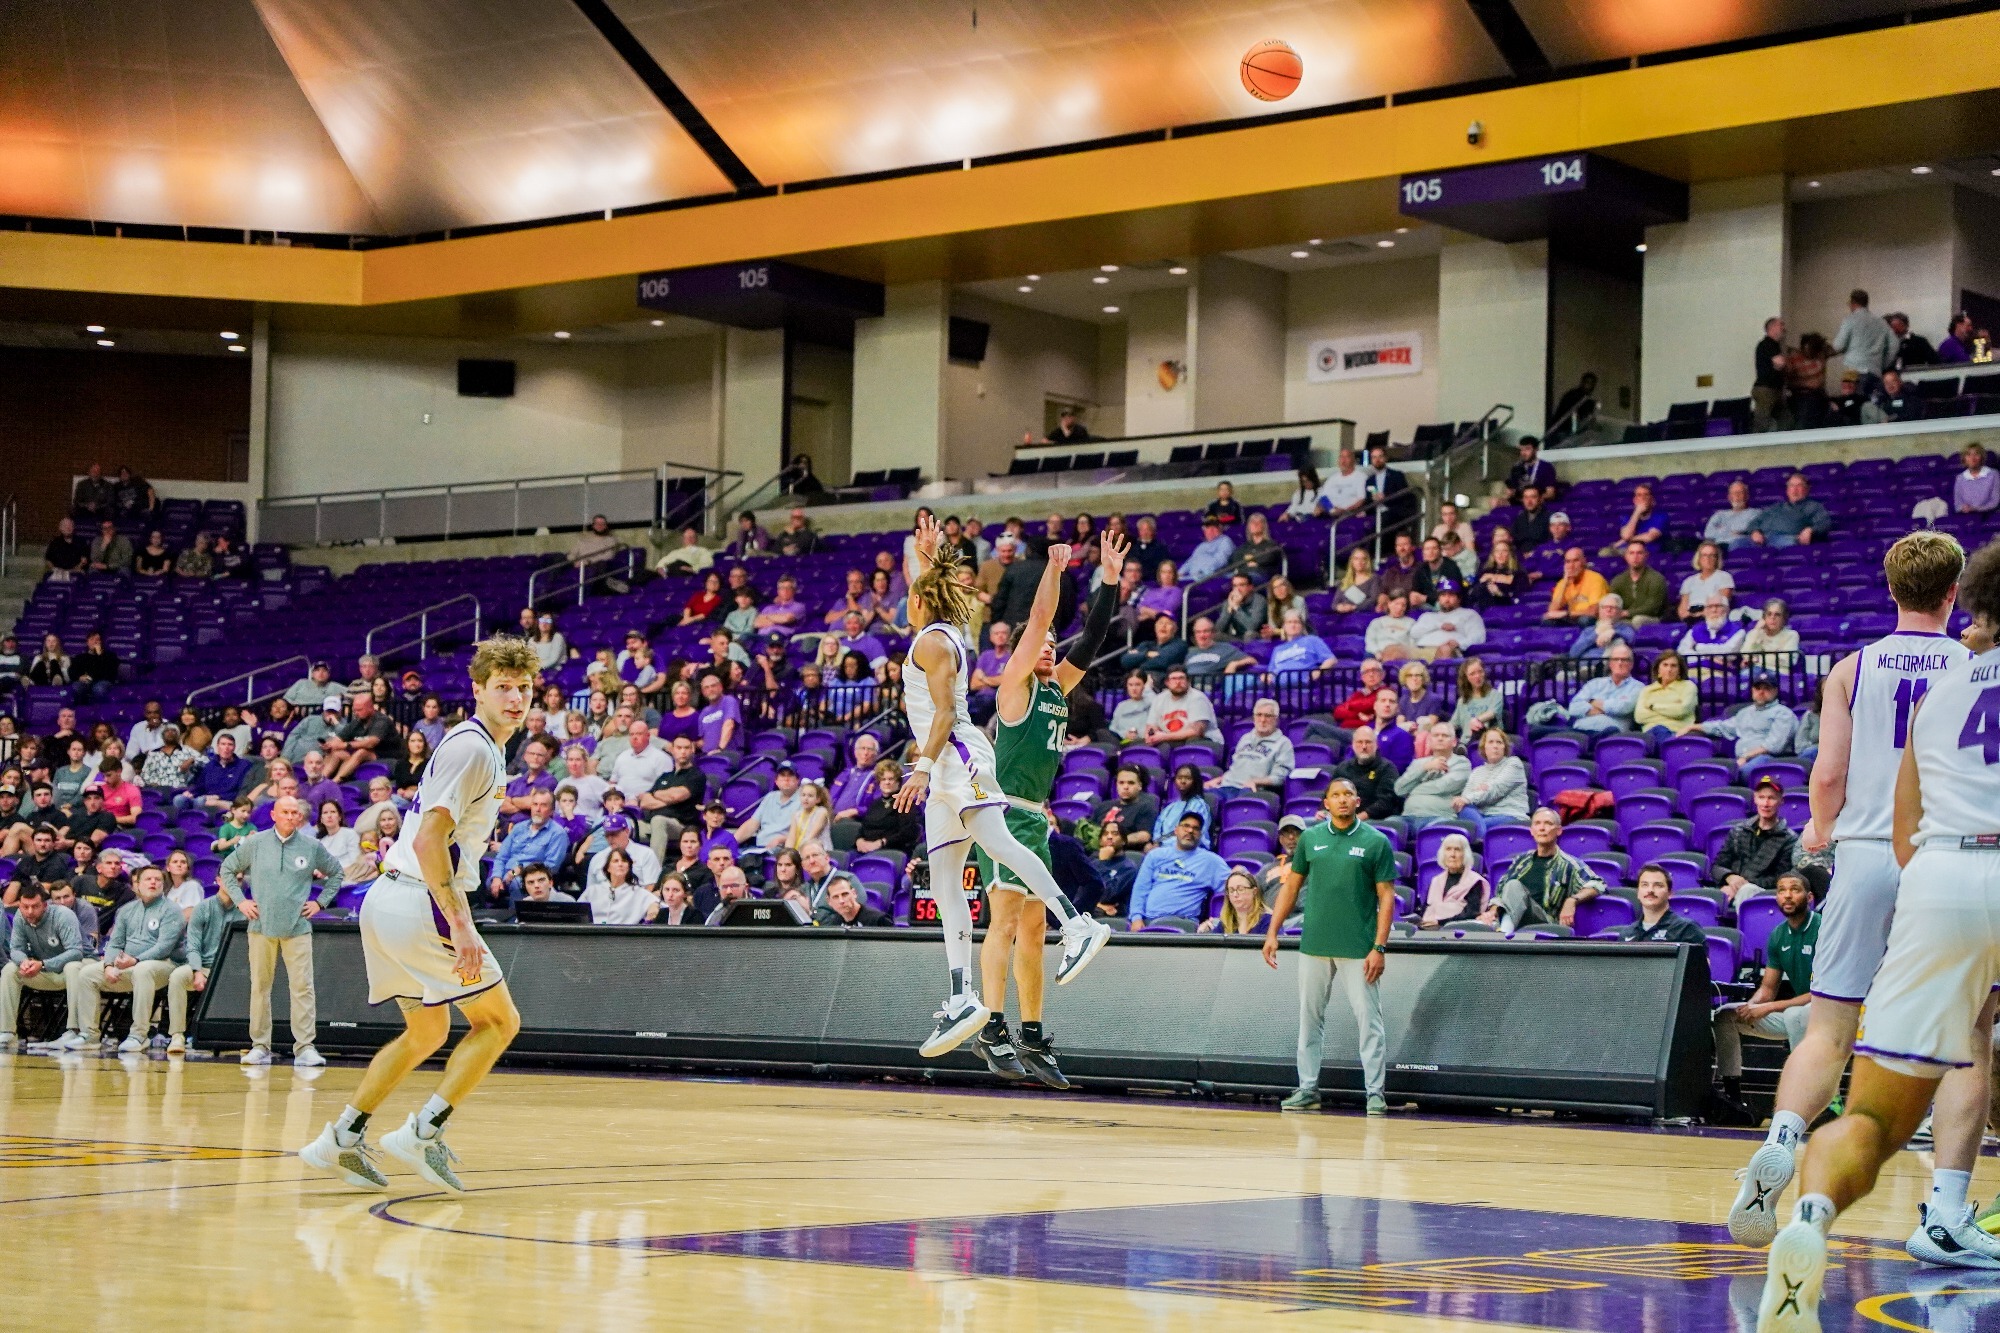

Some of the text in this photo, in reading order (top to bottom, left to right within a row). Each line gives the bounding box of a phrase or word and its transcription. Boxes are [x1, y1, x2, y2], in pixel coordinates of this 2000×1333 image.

[1540, 158, 1583, 186] 104
[1402, 178, 1442, 204] 105
[640, 277, 670, 299] 106
[738, 267, 769, 289] 105
[1878, 654, 1949, 673] McCORMACK
[1958, 685, 2000, 765] 4
[971, 782, 988, 800] L
[915, 890, 931, 899] HOM
[753, 908, 772, 920] POSS
[916, 900, 936, 920] 56
[1395, 1063, 1439, 1071] DAKTRONICS
